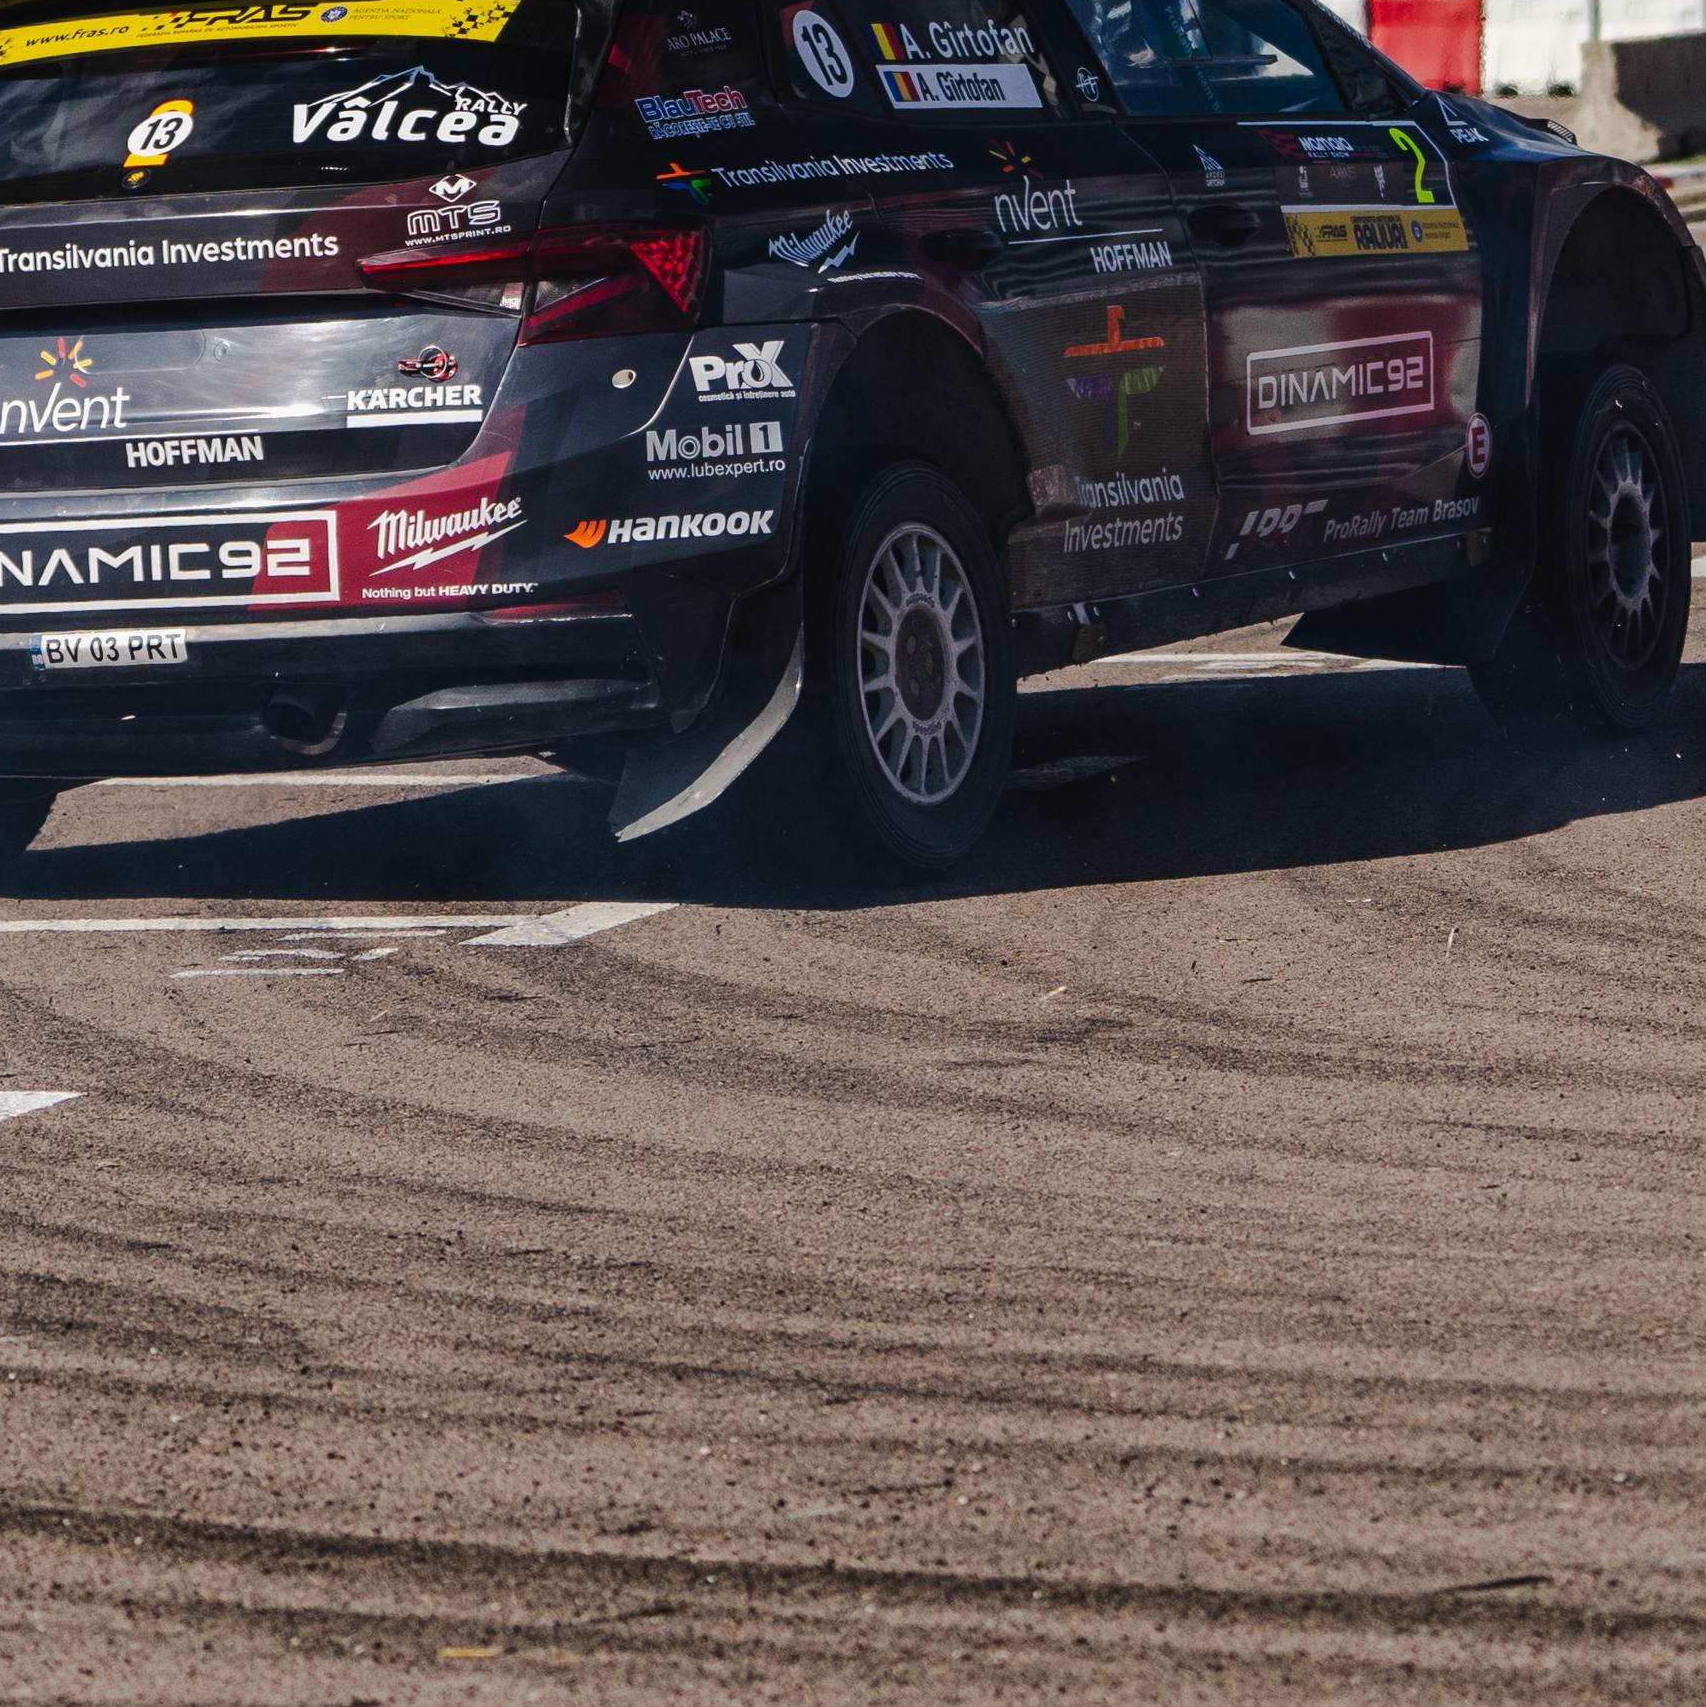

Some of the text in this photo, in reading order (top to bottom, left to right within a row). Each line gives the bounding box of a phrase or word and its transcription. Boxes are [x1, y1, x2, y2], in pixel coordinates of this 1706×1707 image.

[26, 23, 130, 48] www.fras.ro
[690, 27, 732, 46] PALACE
[899, 19, 1035, 59] A. Gîrtofan
[802, 22, 848, 86] 13
[635, 86, 747, 122] BlauTech
[916, 72, 940, 101] A.
[293, 96, 520, 146] Vâlcea
[455, 96, 528, 116] RALLY
[140, 115, 179, 151] 13
[1449, 127, 1489, 144] PEAK
[711, 149, 954, 188] Transilvania Investments
[1389, 127, 1435, 203] 2
[405, 224, 512, 247] WWW.MTSPRINT.RO
[407, 199, 501, 236] MTS
[162, 231, 340, 265] Investments
[768, 209, 854, 267] Milwaukee
[1091, 241, 1173, 274] HOFFMAN
[125, 434, 265, 469] HOFFMAN
[646, 424, 744, 462] Mobil
[1470, 426, 1486, 464] E
[648, 458, 786, 481] www.lubexpert.ro
[1063, 511, 1185, 553] Investments
[1323, 495, 1480, 543] ProRally Team Brasov
[362, 586, 411, 600] Nothing
[414, 586, 436, 598] but
[438, 584, 489, 596] HEAVY
[45, 634, 182, 665] BV 03 PRT
